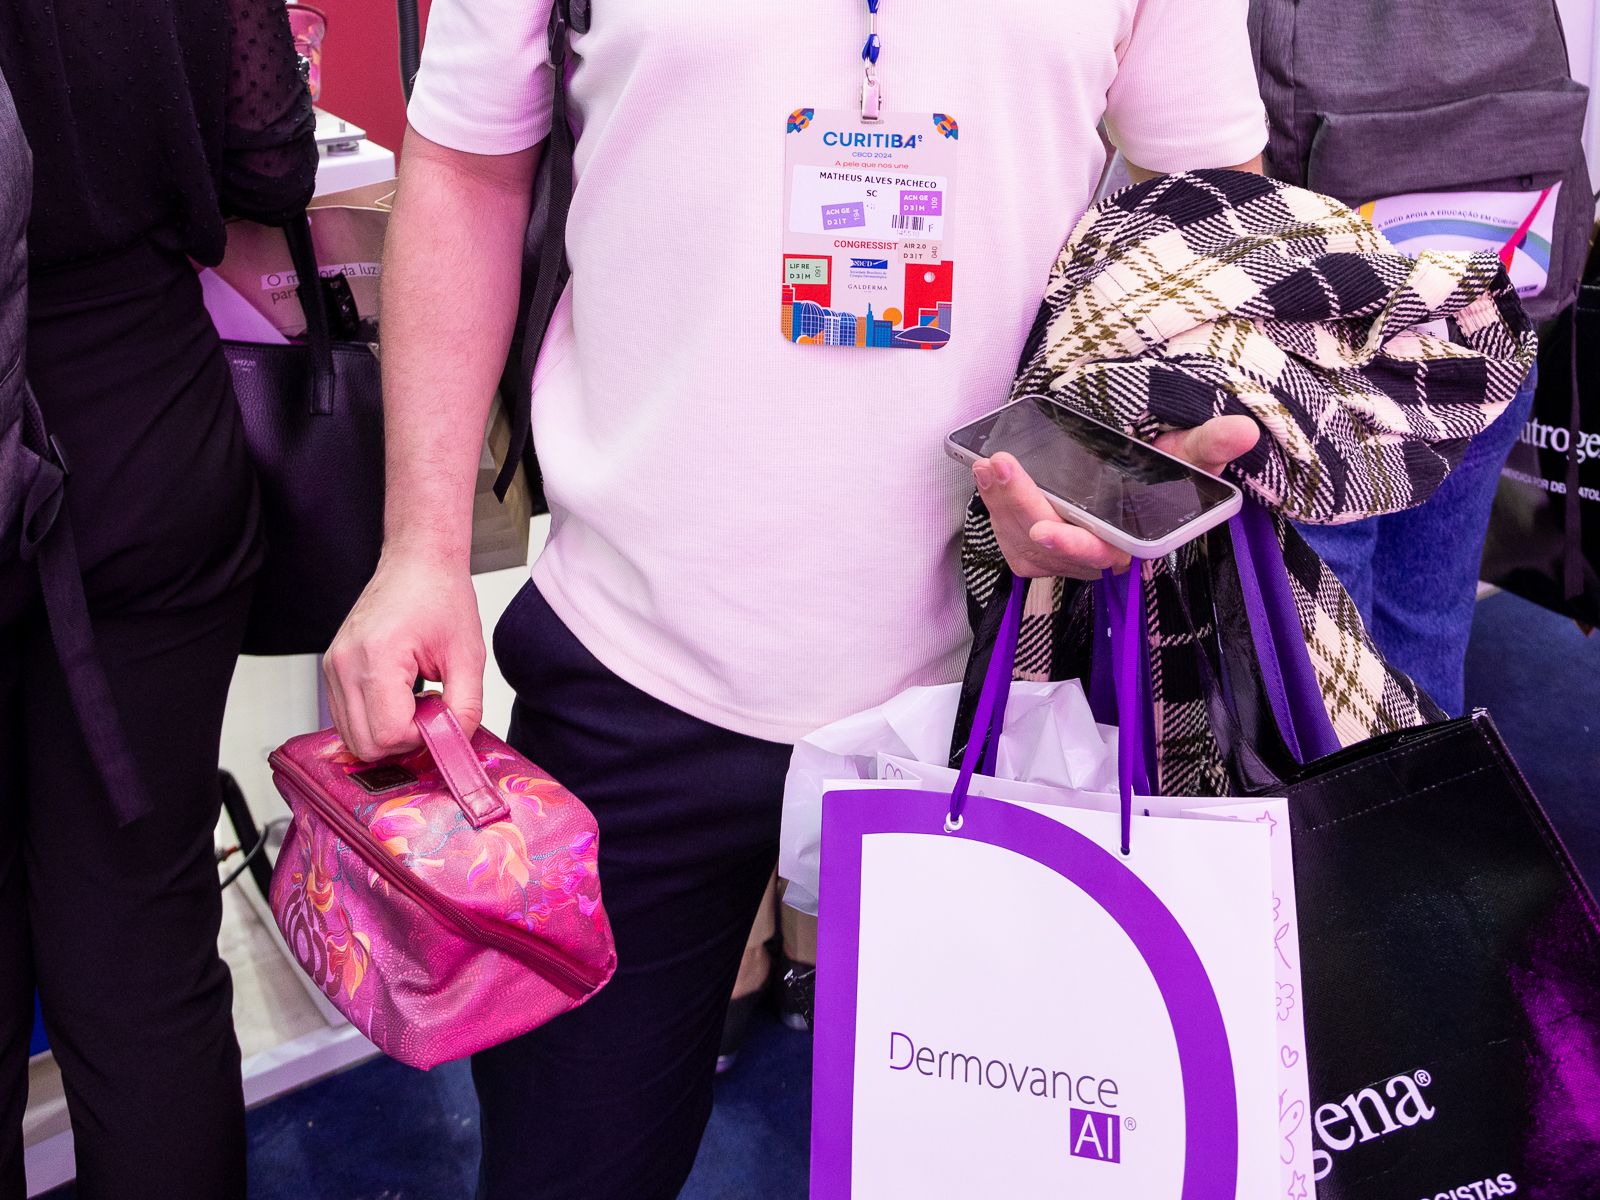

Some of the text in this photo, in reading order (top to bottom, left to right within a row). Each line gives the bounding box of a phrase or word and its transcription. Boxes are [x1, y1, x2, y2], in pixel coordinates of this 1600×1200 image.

[819, 171, 937, 189] MATHEUS ALVES PACHECO
[866, 189, 878, 198] SC
[1405, 210, 1428, 220] APOIA
[1437, 209, 1479, 219] EDUCAÇÃO
[833, 239, 899, 250] CONGRESSIST
[266, 274, 281, 287] O
[359, 263, 378, 275] luz
[847, 283, 888, 292] GALDERMA
[889, 1031, 1119, 1109] Dermovance
